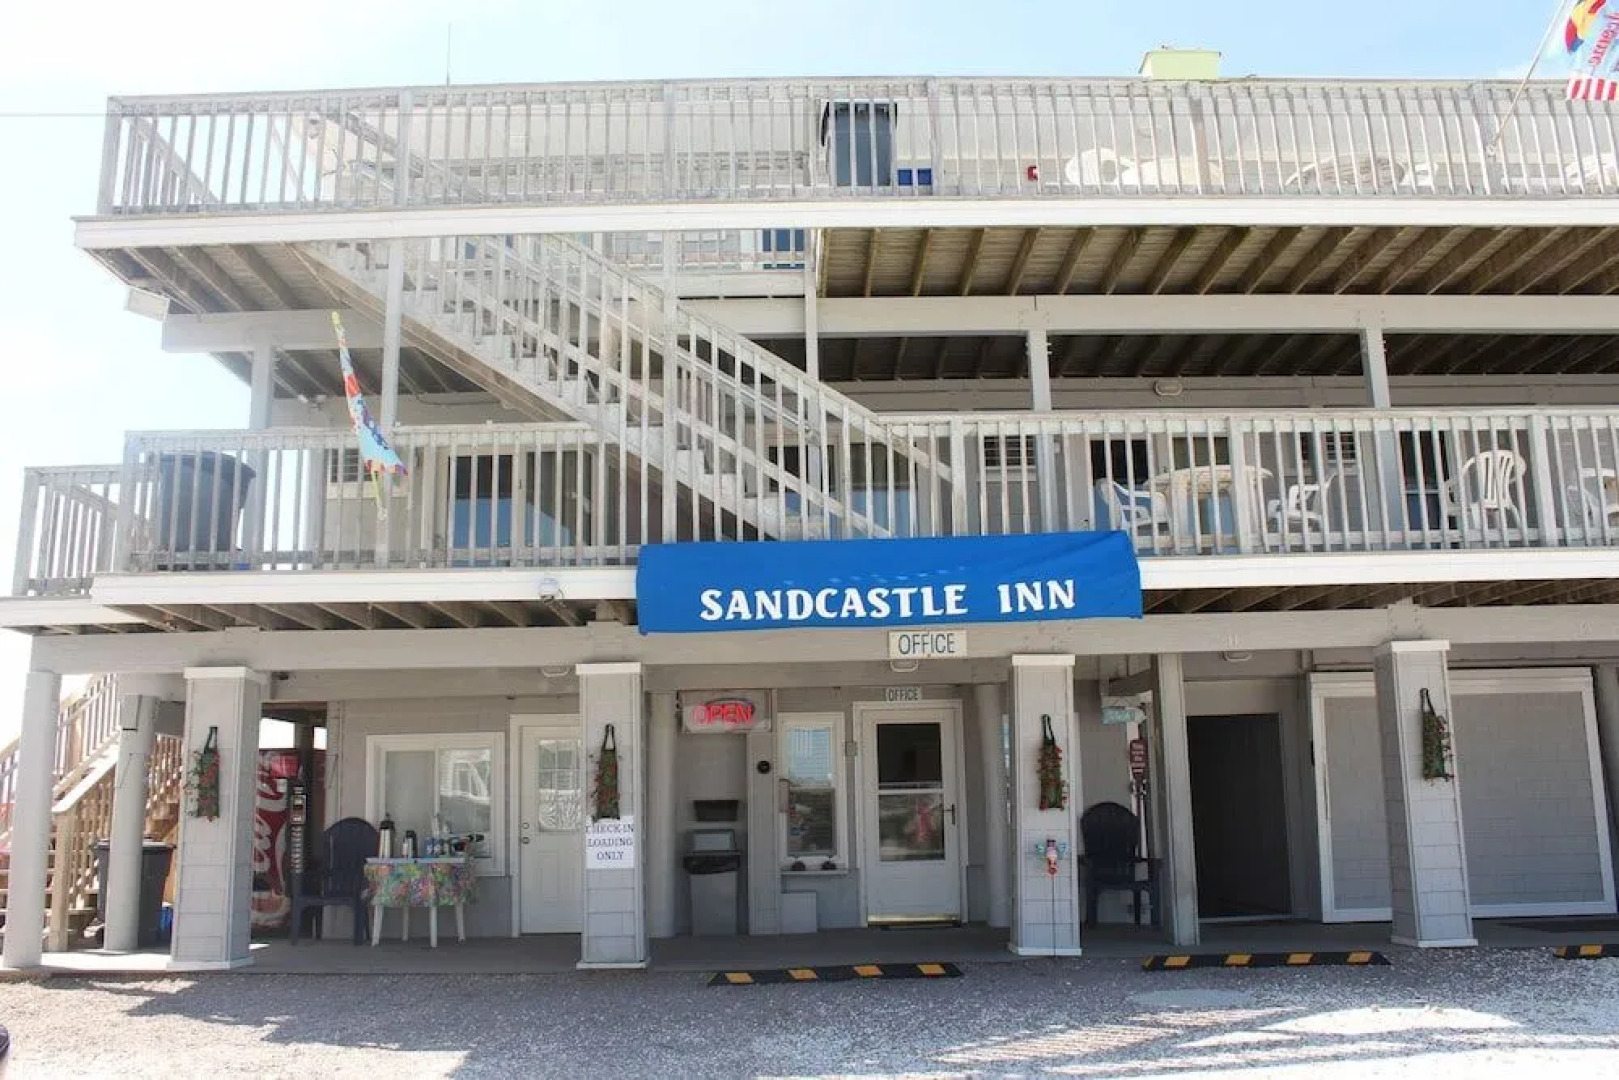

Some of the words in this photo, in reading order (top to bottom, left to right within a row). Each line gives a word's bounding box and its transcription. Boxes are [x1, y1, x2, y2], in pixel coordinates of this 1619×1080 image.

[700, 584, 967, 621] SANDCASTLE
[996, 579, 1075, 614] INN
[898, 632, 956, 655] OFFICE
[888, 688, 919, 702] OFFICE
[693, 704, 752, 725] OPEN
[587, 837, 634, 848] LOADING
[597, 851, 624, 861] ONLY
